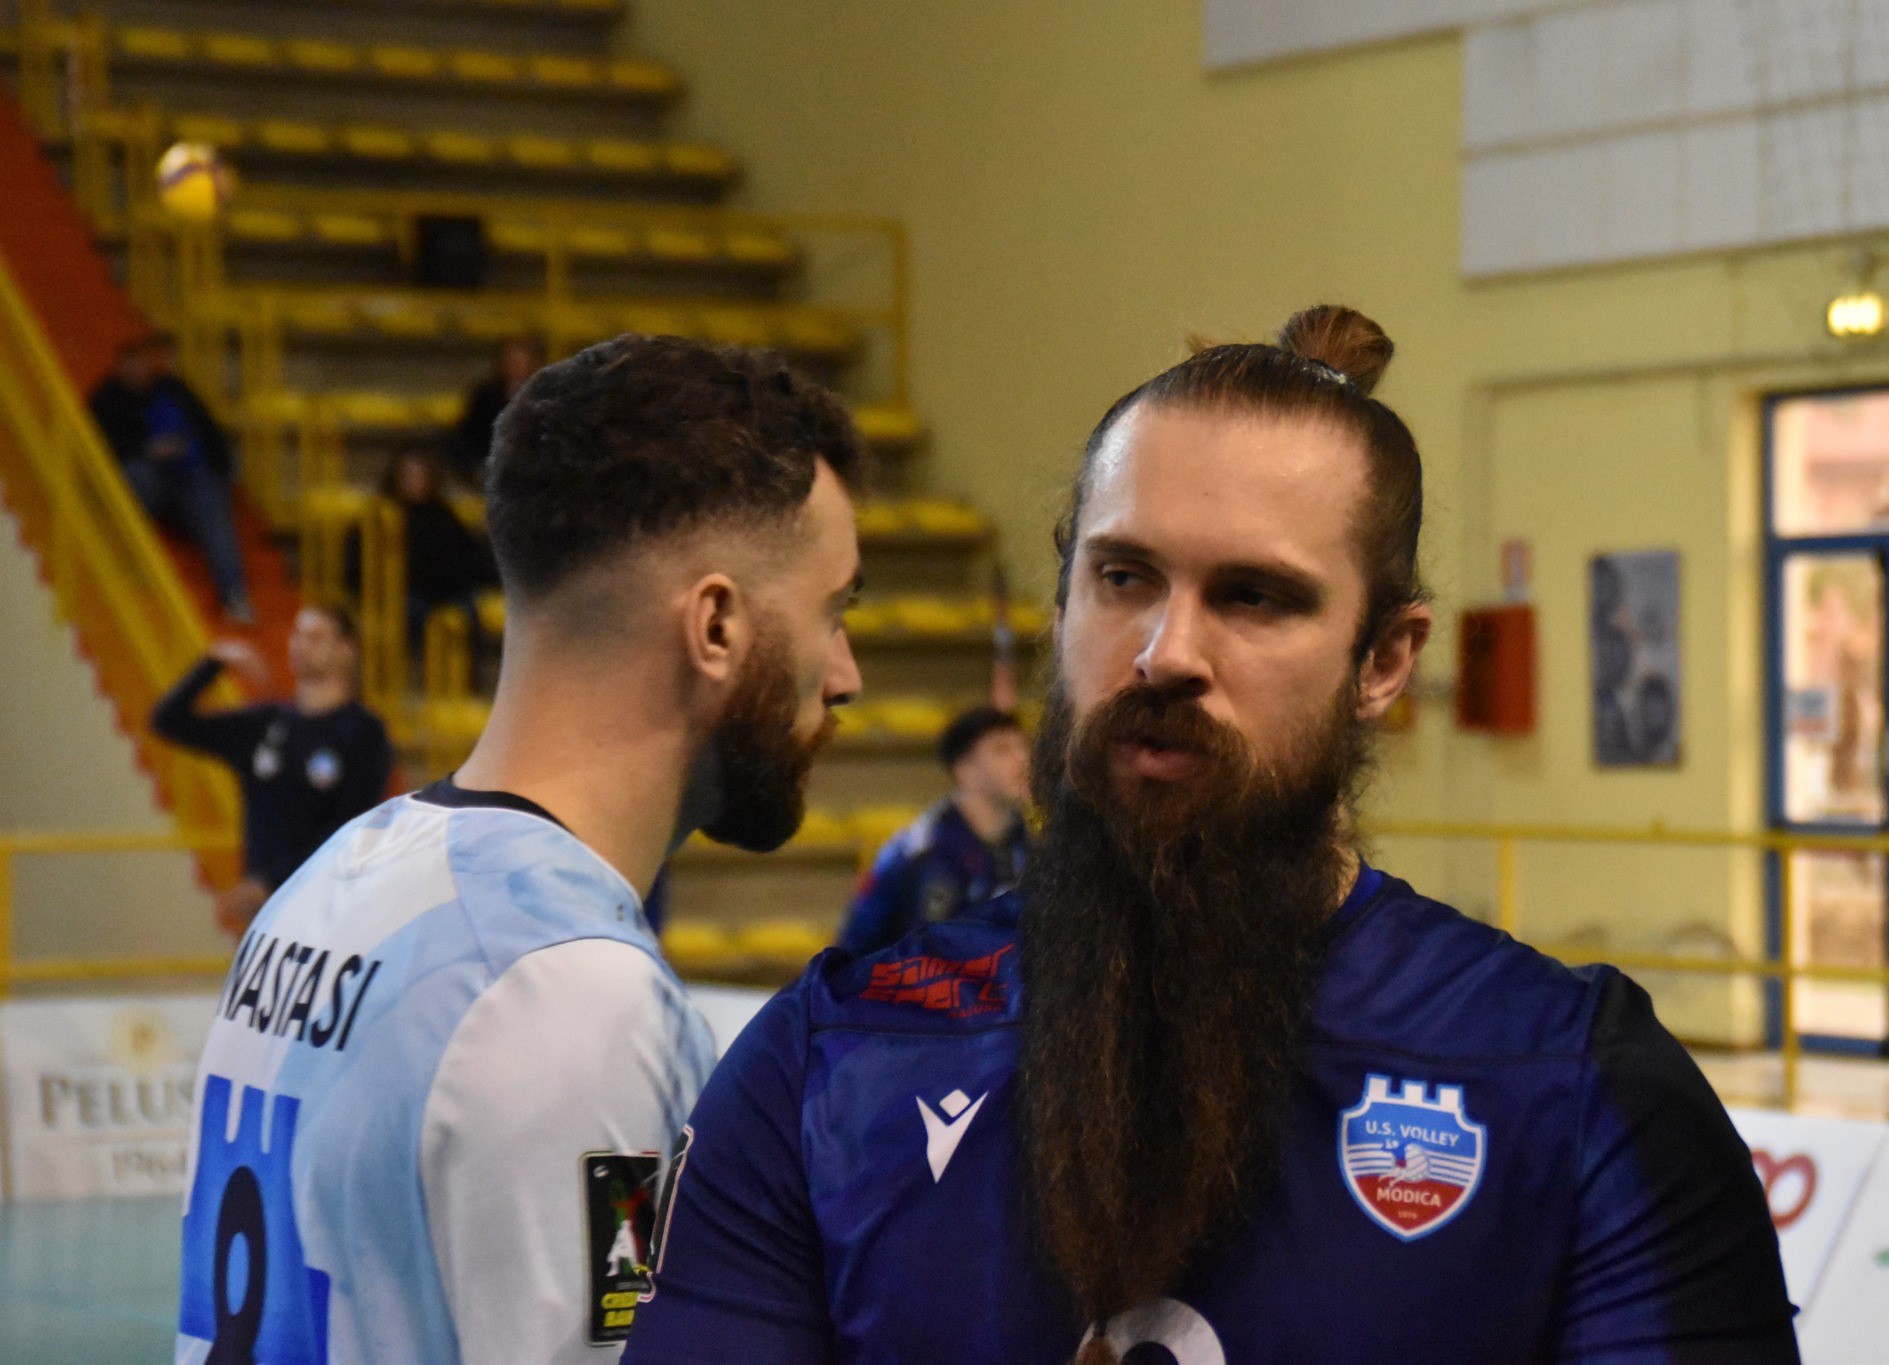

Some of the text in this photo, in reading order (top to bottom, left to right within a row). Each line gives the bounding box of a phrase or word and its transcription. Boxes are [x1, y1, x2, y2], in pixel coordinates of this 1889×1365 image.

[1365, 1120, 1460, 1147] U.S. VOLLEY
[1376, 1188, 1442, 1207] MODICA
